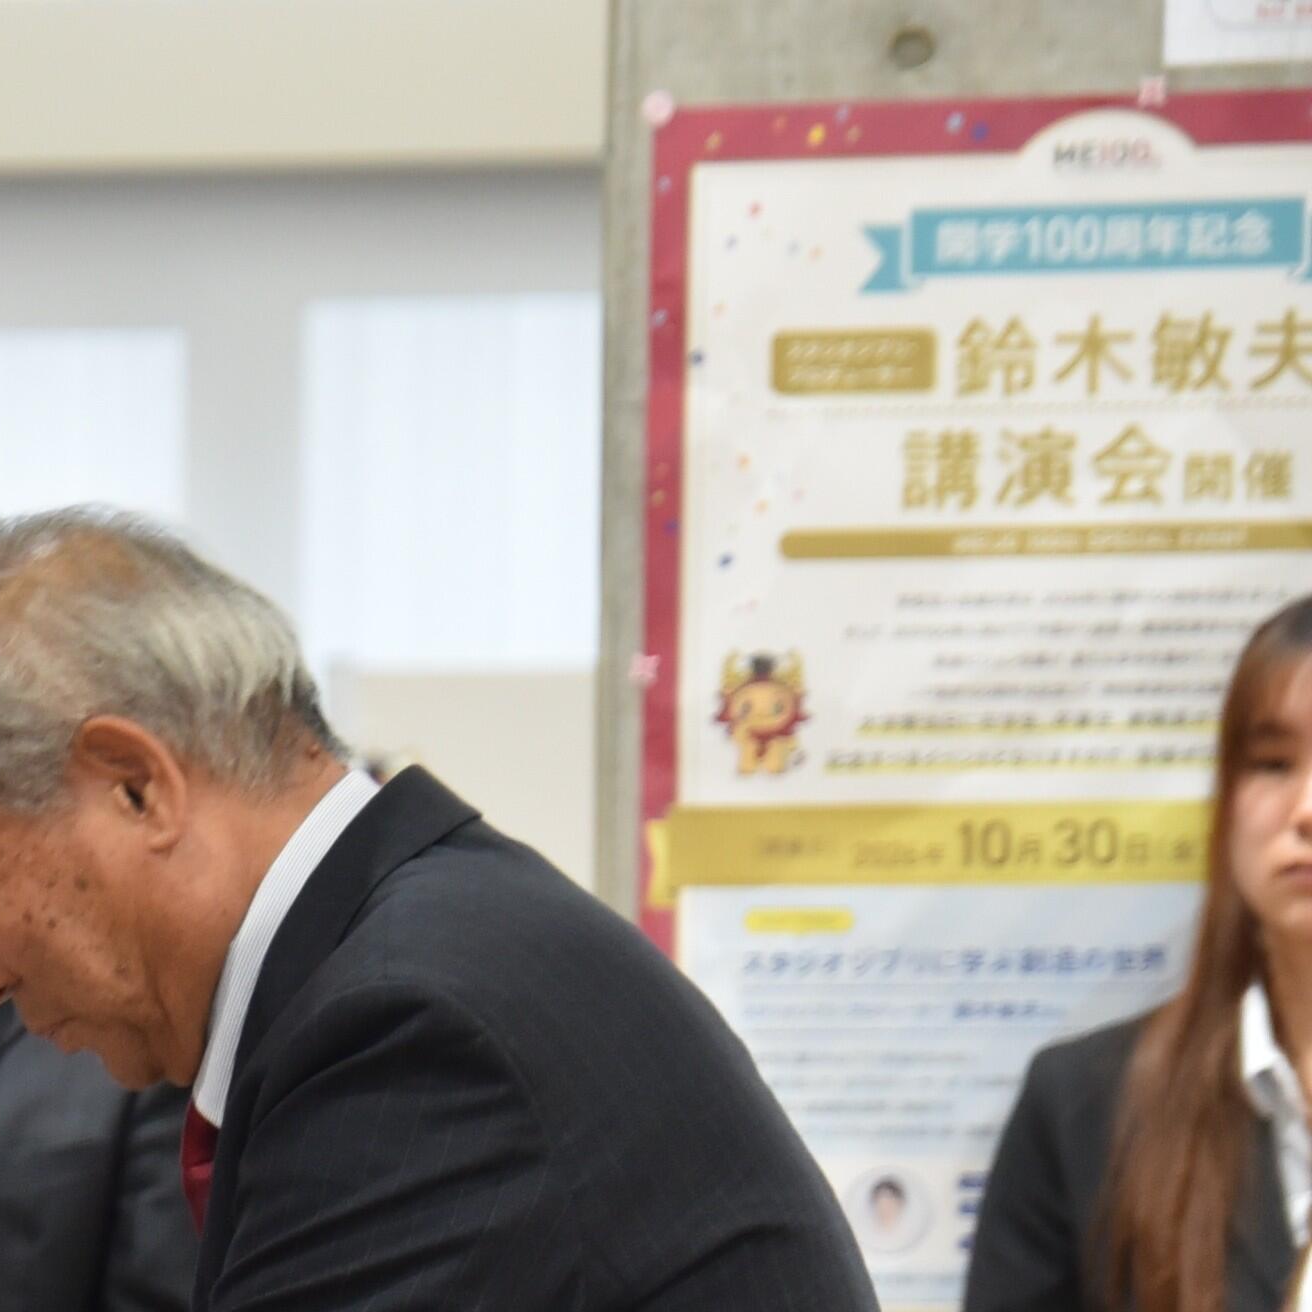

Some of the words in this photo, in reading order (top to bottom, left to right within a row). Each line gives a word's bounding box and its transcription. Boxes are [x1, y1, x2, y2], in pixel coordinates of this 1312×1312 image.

[955, 308, 1312, 397] 鈴木敏夫
[900, 424, 1294, 511] 講演会開催
